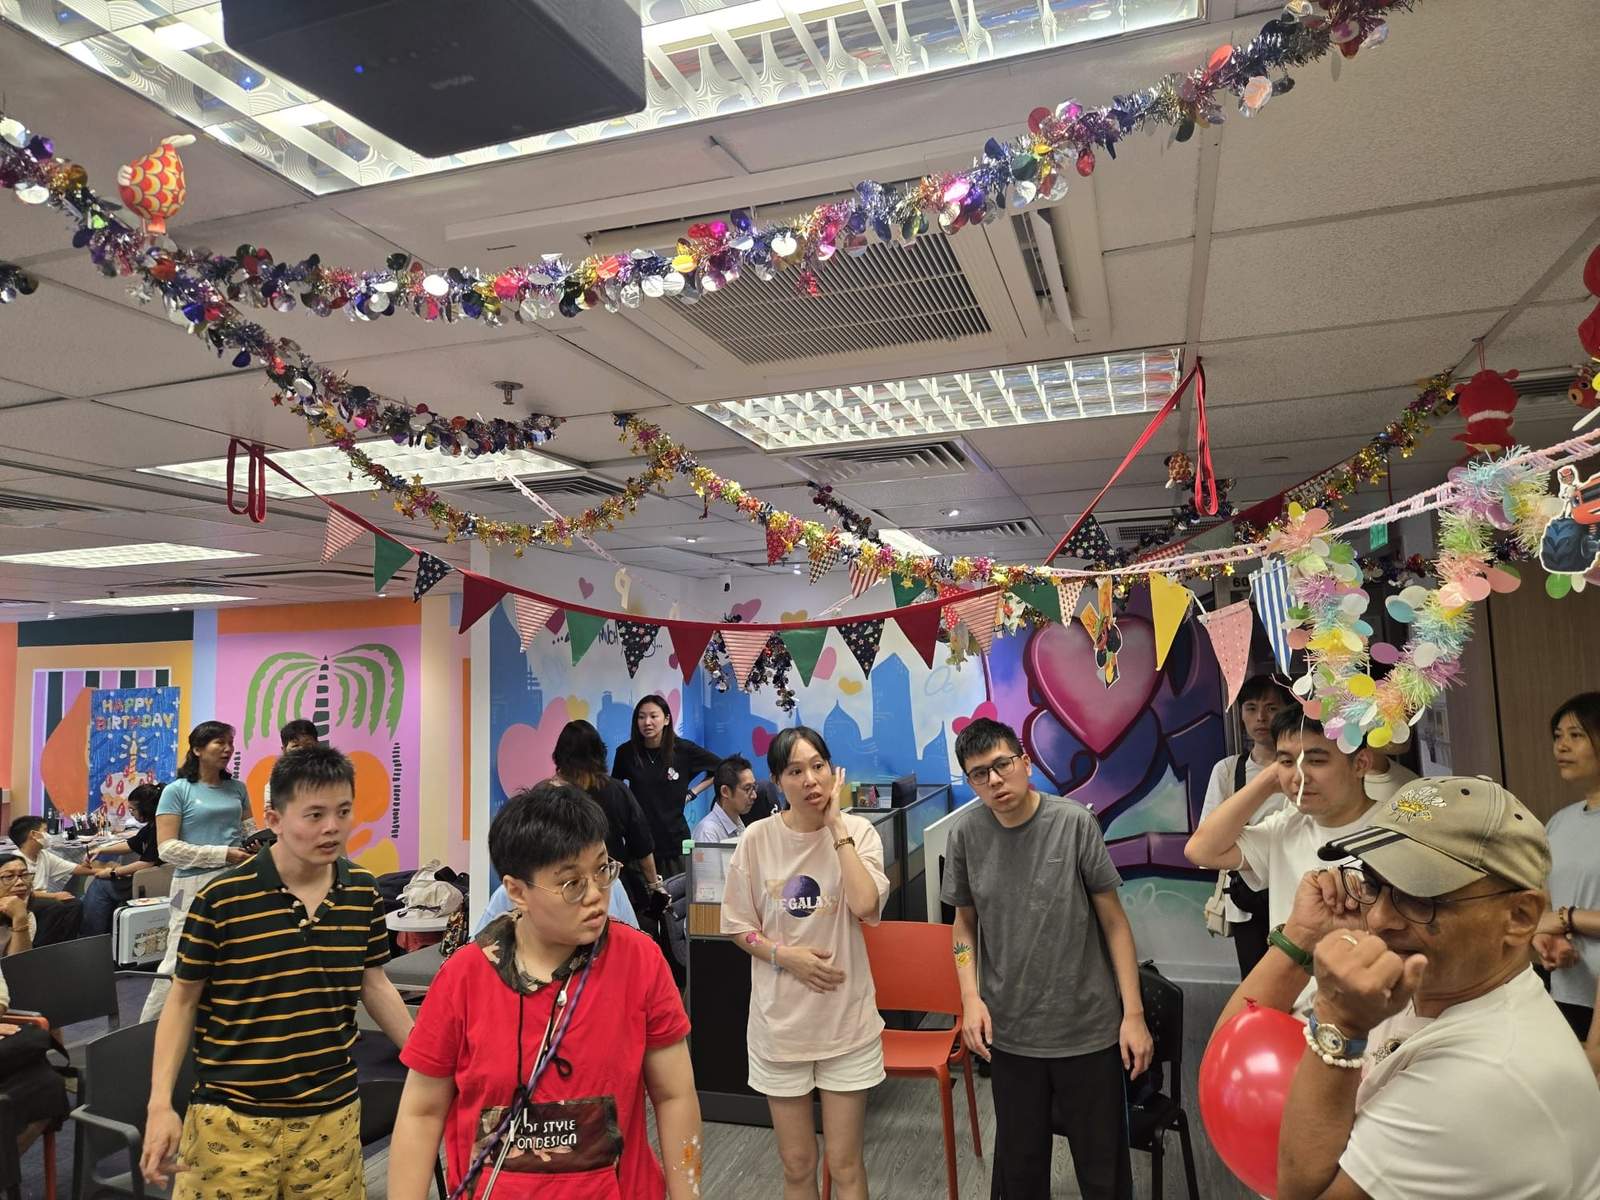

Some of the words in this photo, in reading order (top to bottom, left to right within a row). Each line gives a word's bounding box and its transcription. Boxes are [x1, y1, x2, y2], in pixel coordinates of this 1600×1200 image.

[102, 697, 153, 713] HAPPY
[96, 713, 175, 731] BIRTHDAY
[543, 1120, 576, 1133] STYLE
[536, 1133, 577, 1149] DESIGN
